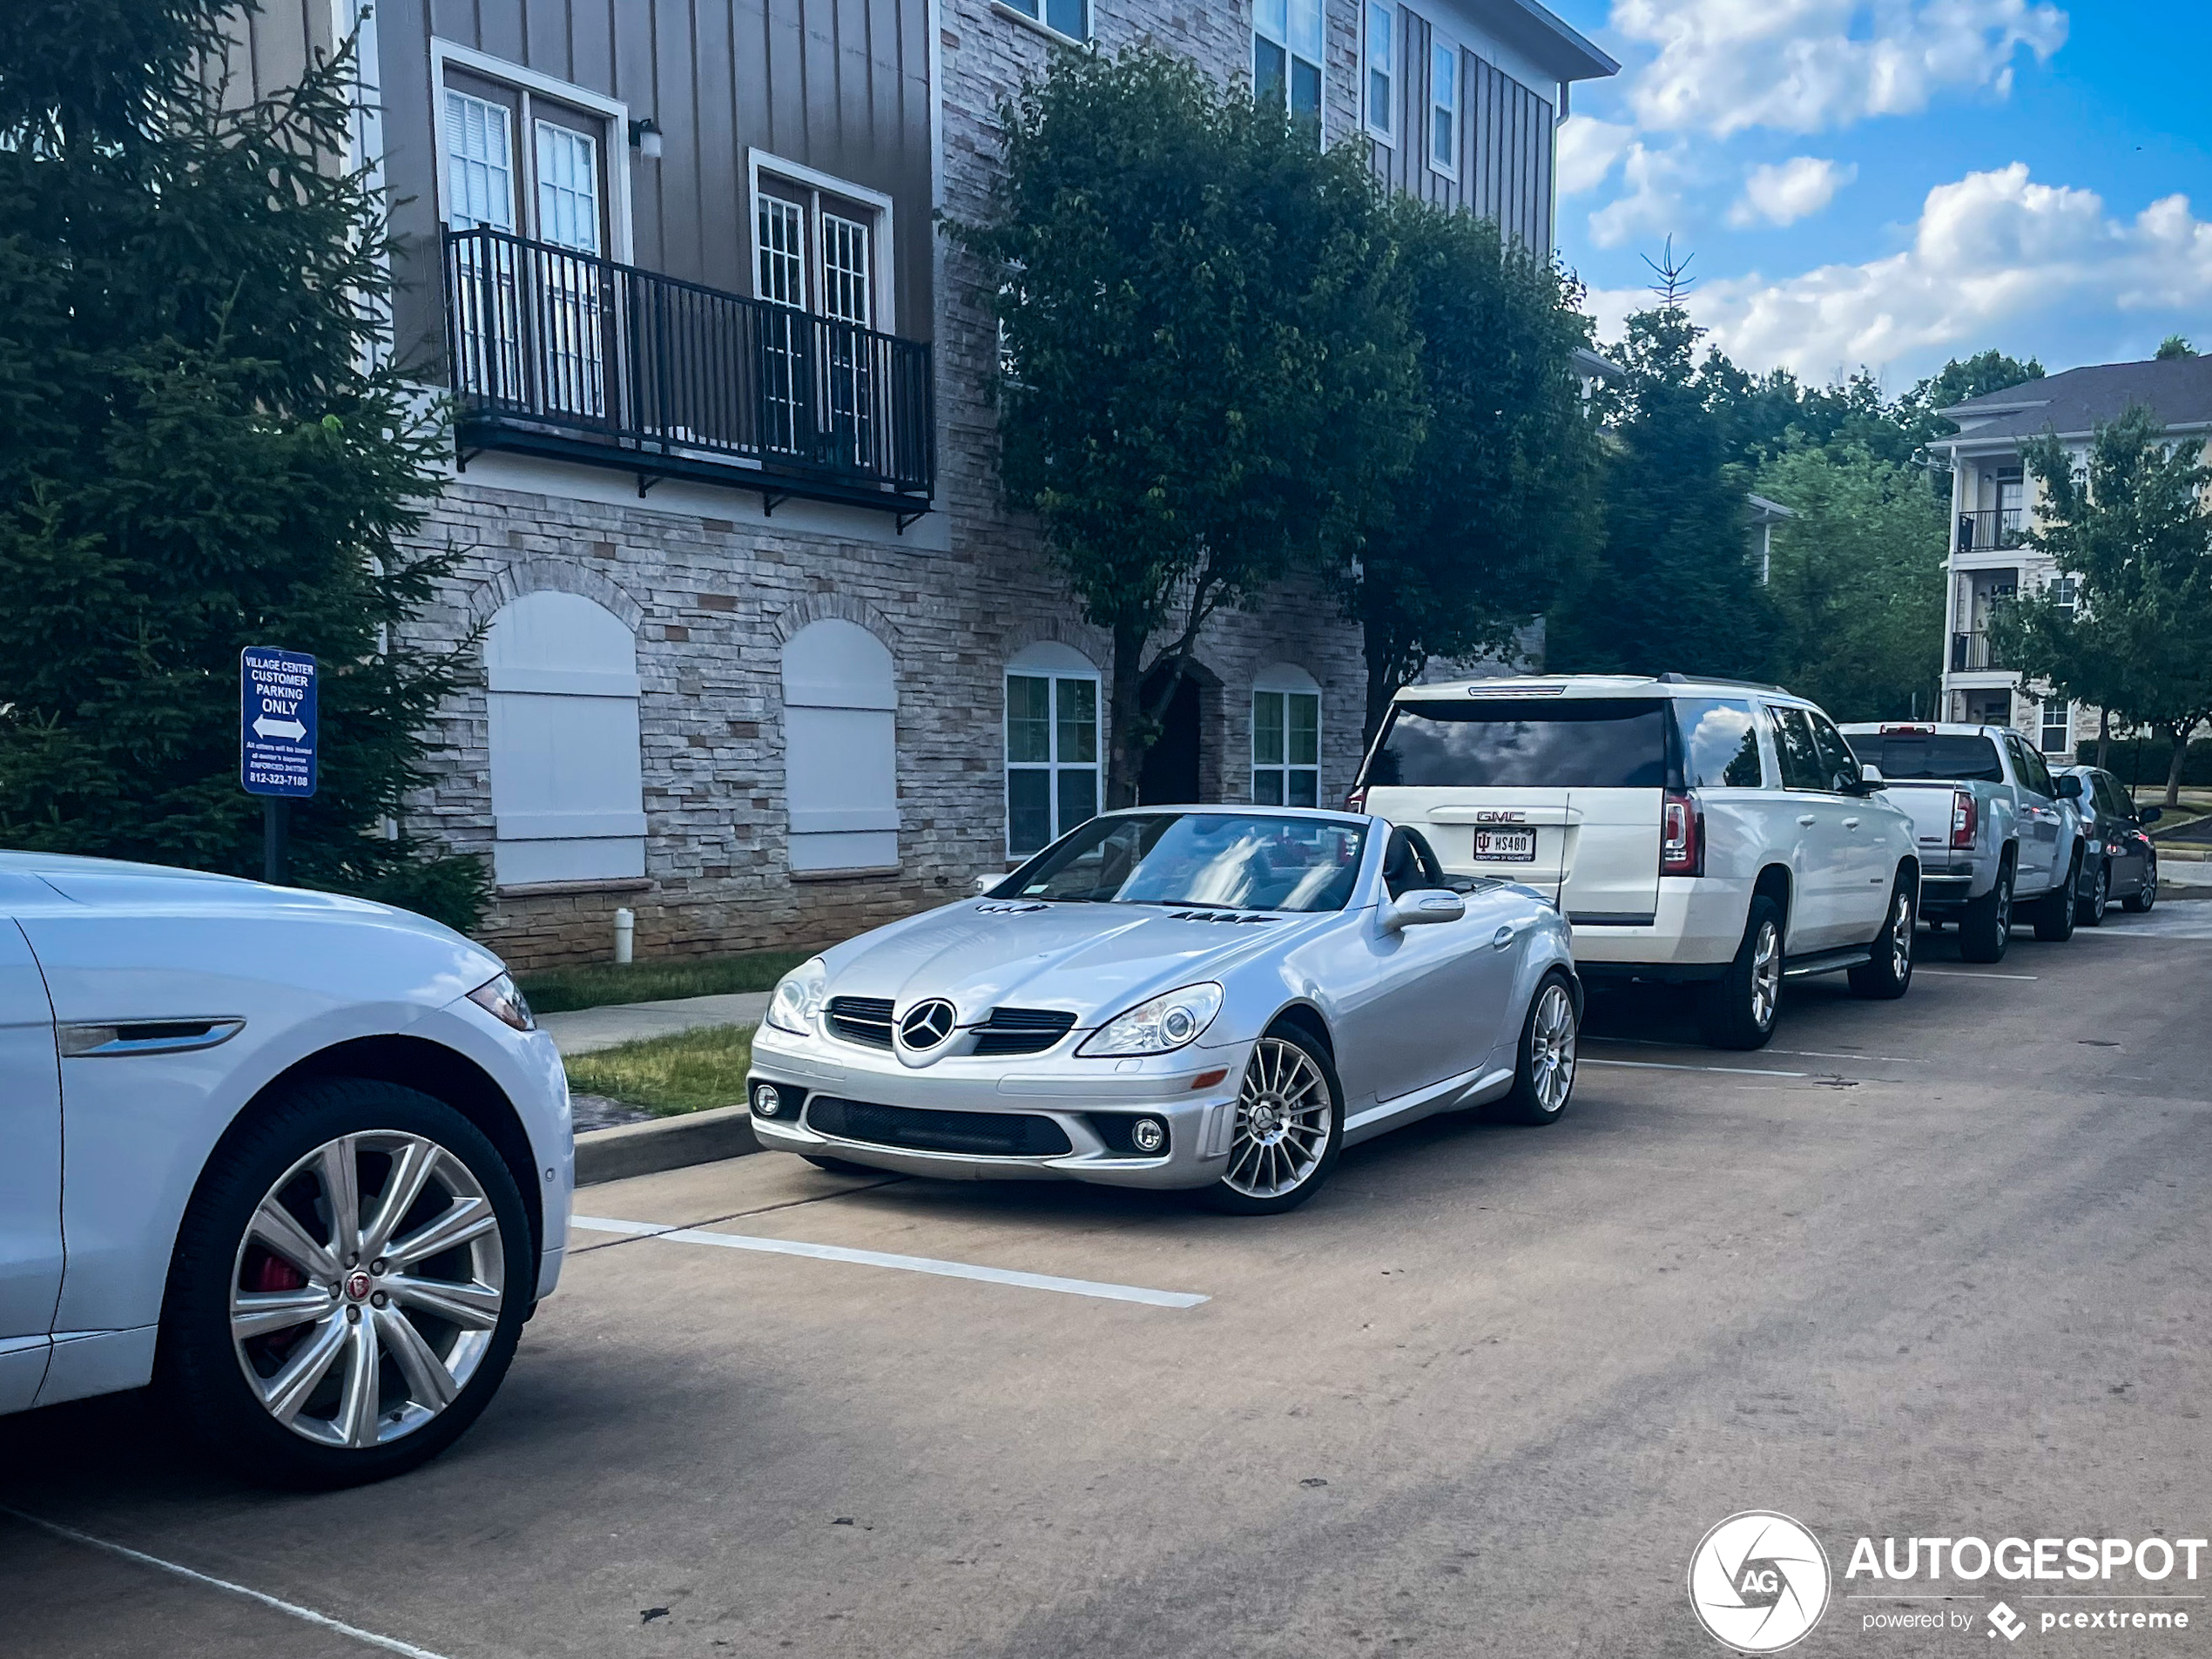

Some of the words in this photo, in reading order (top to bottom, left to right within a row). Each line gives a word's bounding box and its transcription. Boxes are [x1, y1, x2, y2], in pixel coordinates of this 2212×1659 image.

[246, 656, 280, 671] VILLAGE
[281, 661, 314, 676] CENTER
[251, 670, 308, 687] CUSTOMER
[256, 684, 304, 700] PARKING
[262, 698, 298, 715] ONLY
[1477, 811, 1526, 822] GMC
